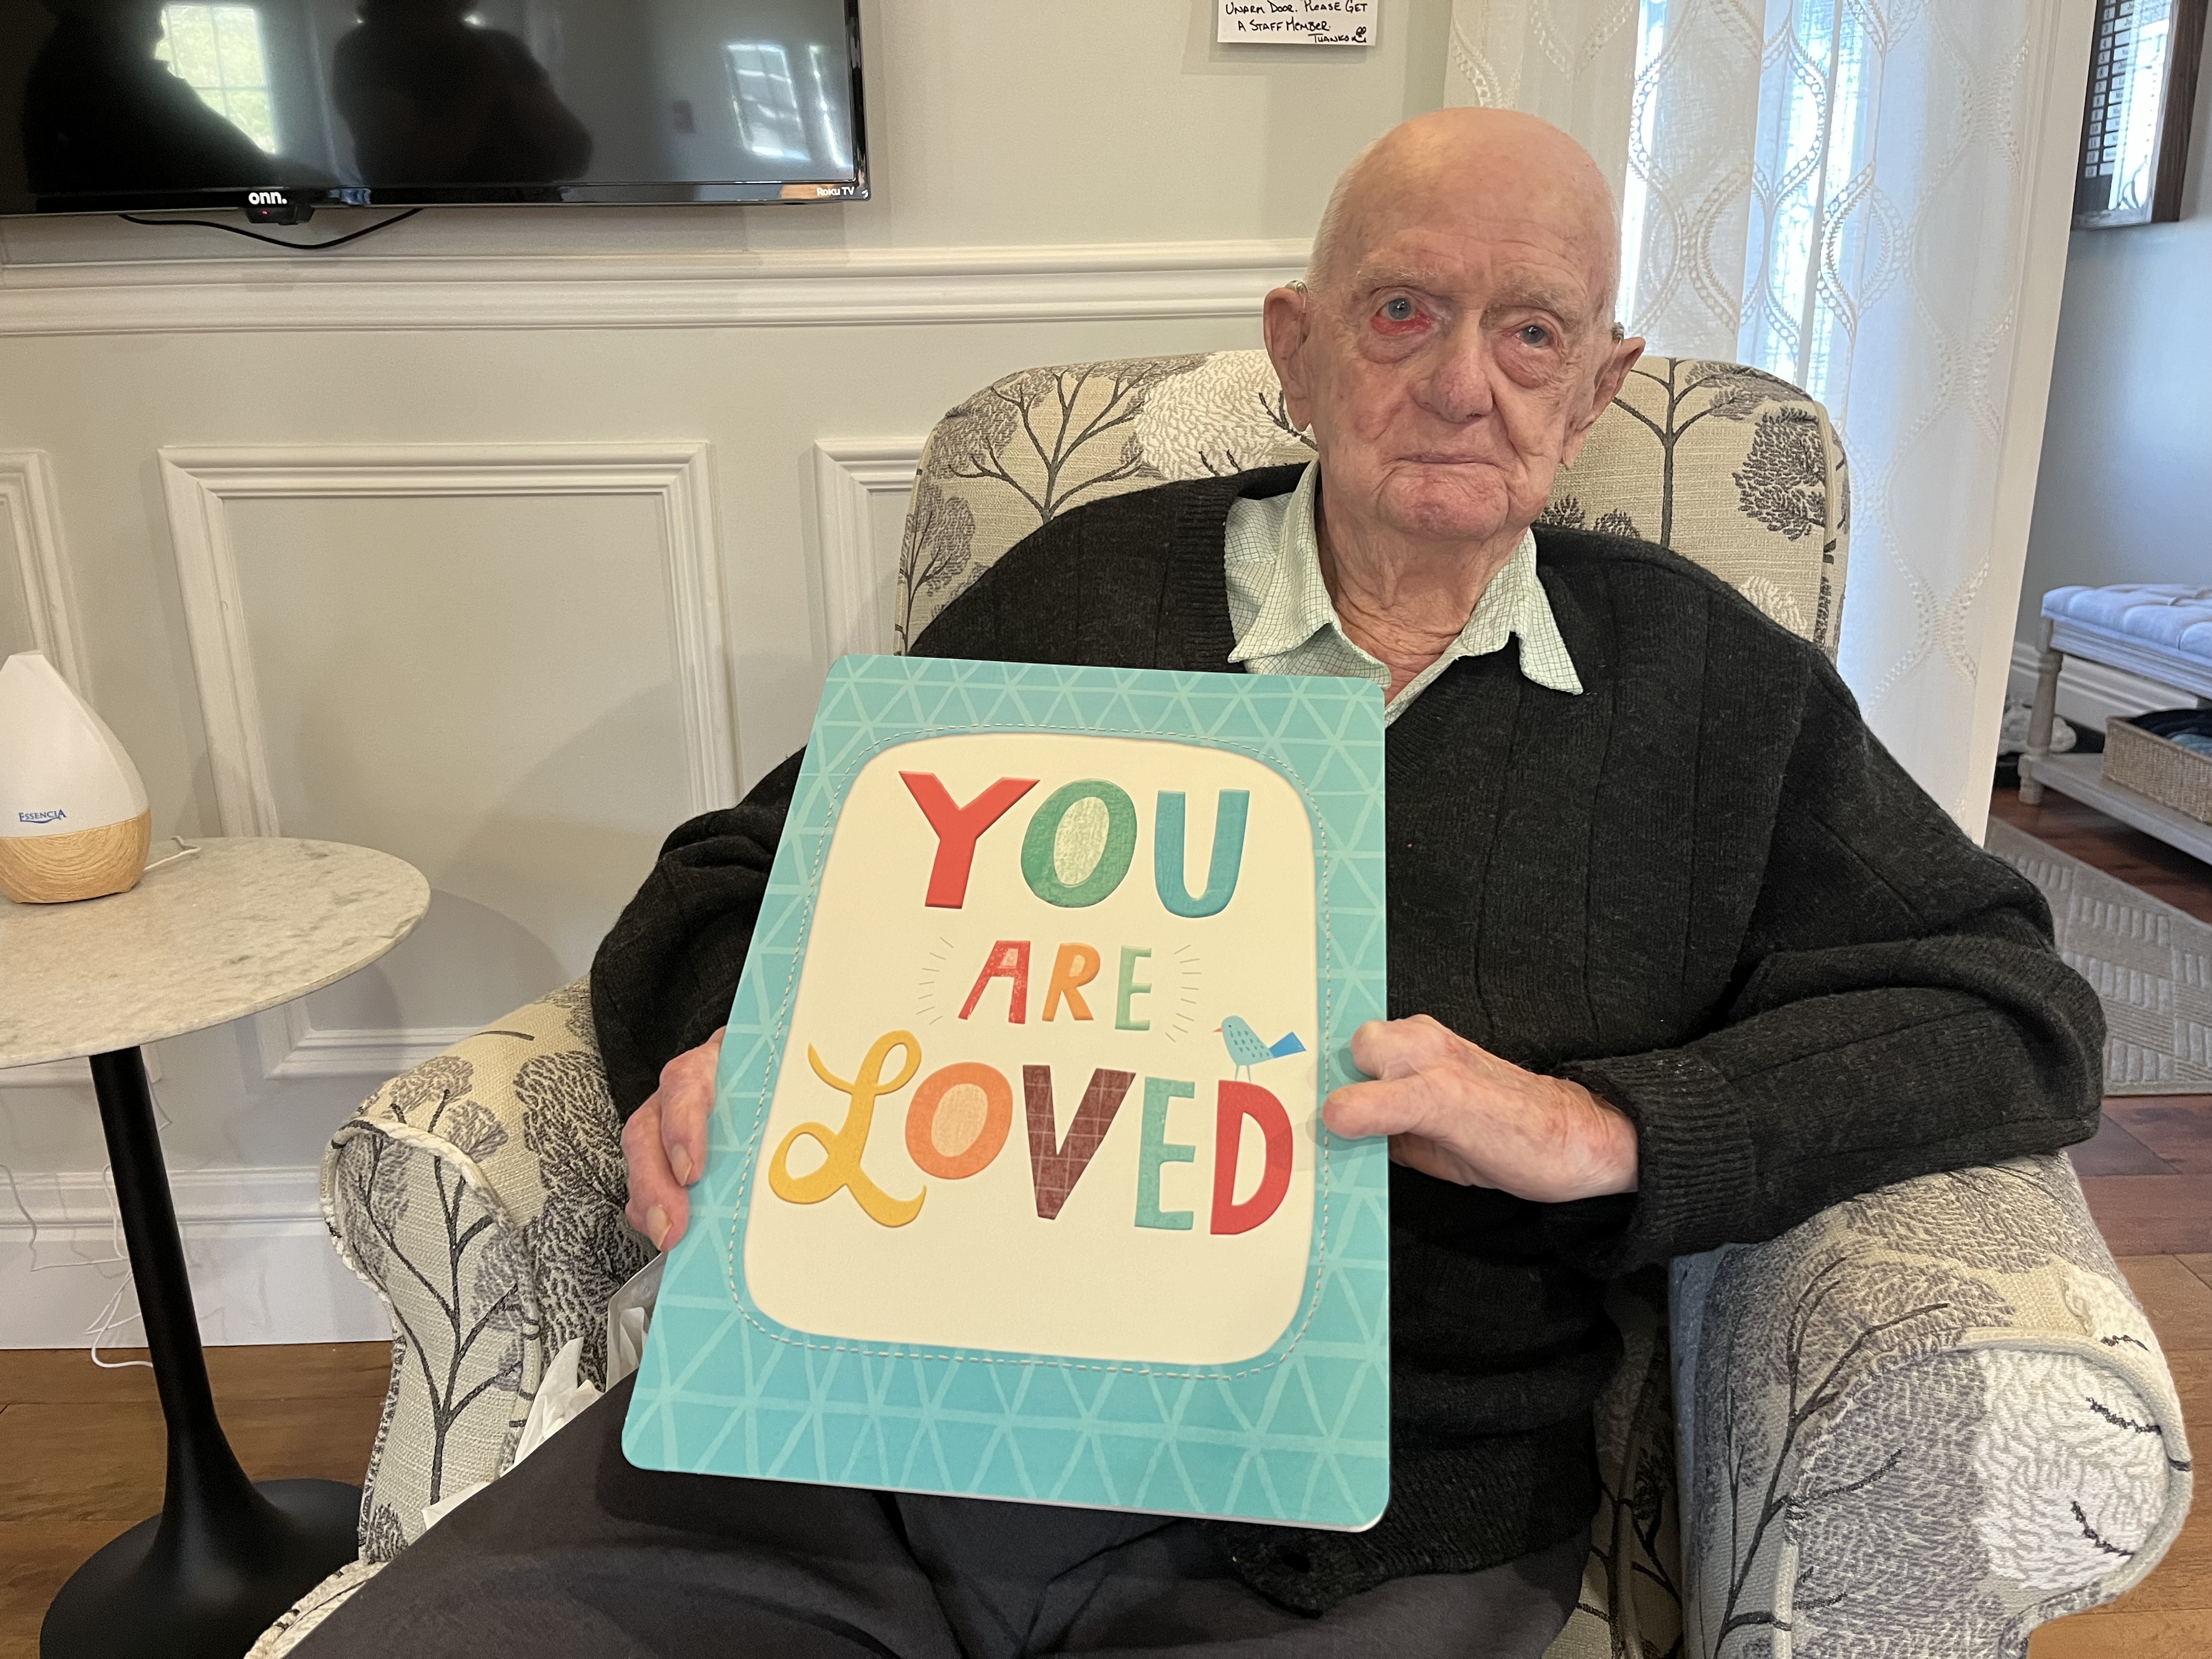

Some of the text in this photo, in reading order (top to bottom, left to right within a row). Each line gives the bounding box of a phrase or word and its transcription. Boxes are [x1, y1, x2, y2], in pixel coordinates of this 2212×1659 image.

[1226, 2, 1265, 15] UNARM
[1345, 0, 1368, 14] GET
[1238, 20, 1246, 32] A
[1249, 19, 1283, 31] STAFF
[249, 192, 287, 205] onn.
[842, 186, 855, 196] TV
[899, 771, 1250, 918] YOU
[957, 940, 1152, 1031] ARE
[768, 1029, 1294, 1235] LOVED
